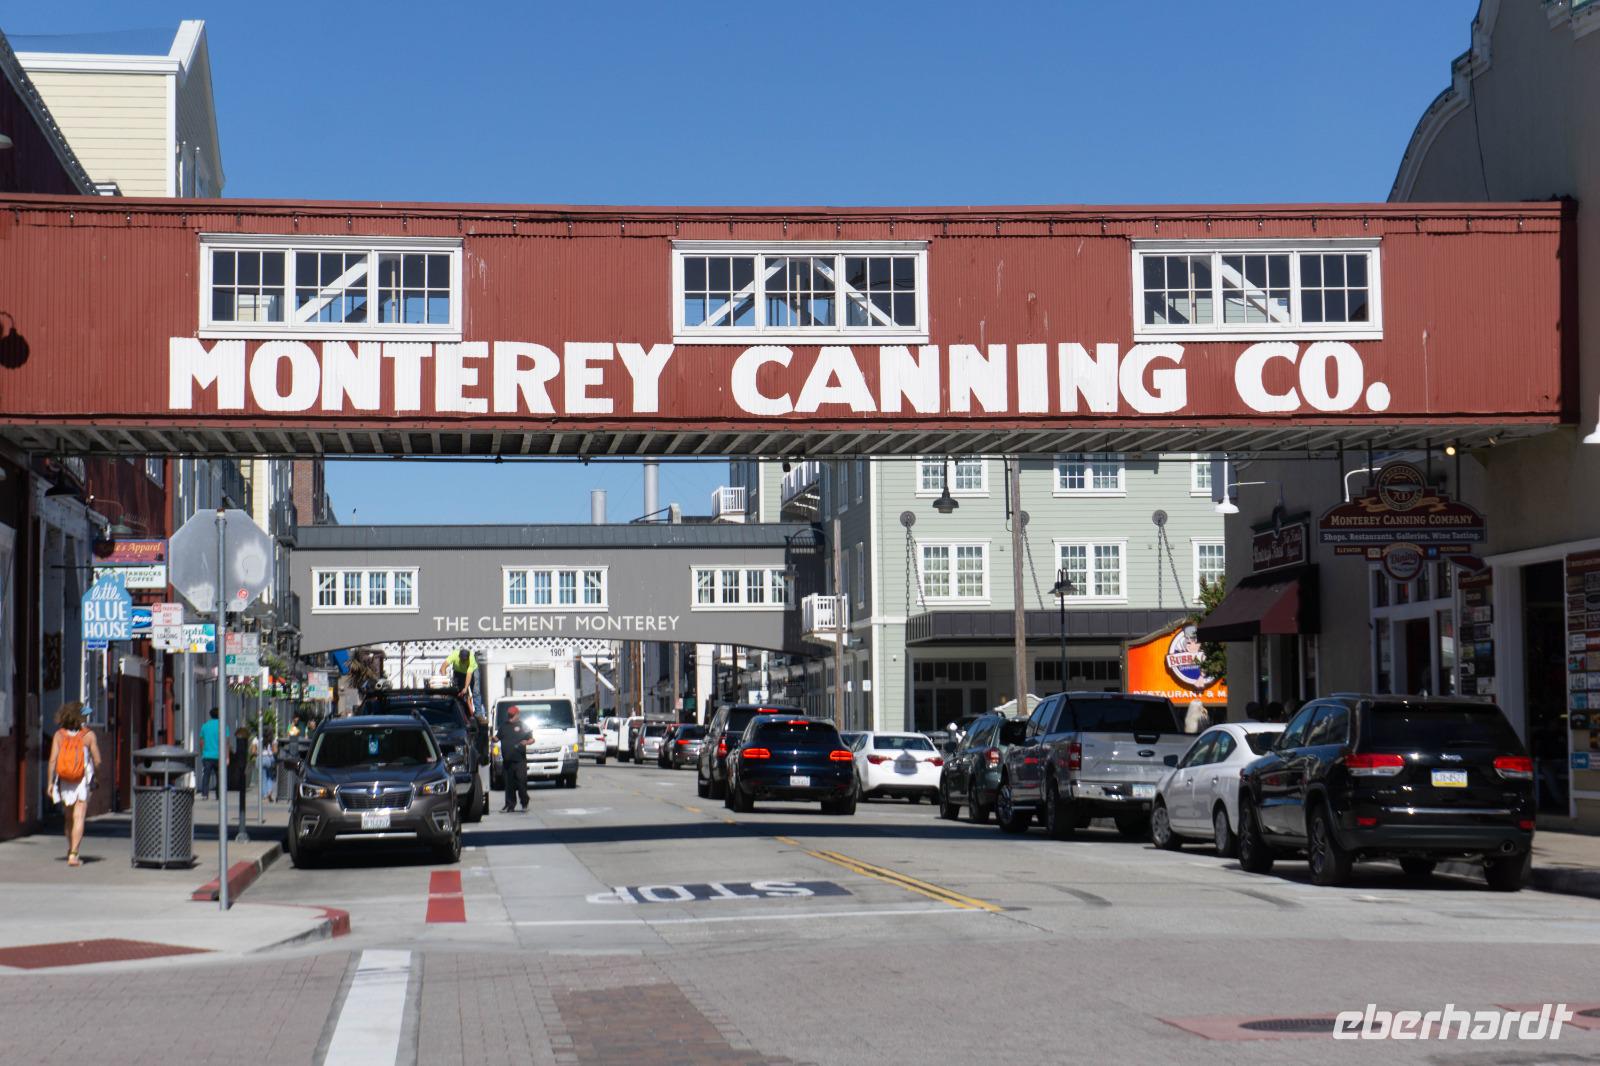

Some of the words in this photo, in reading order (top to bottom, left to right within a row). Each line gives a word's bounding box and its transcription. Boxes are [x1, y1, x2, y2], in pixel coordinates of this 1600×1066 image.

[169, 337, 674, 413] MONTEREY
[731, 341, 1188, 414] CANNING
[1234, 340, 1391, 413] CO.
[1383, 514, 1426, 525] CANNING
[1429, 514, 1473, 524] COMPANY
[128, 543, 161, 554] Apparel
[91, 582, 122, 600] little
[84, 601, 129, 621] BLUE
[84, 621, 129, 639] HOUSE
[433, 616, 469, 631] THE
[478, 616, 567, 631] CLEMENT
[575, 615, 680, 631] MONTEREY
[550, 648, 566, 657] 1901
[585, 880, 815, 904] STOP
